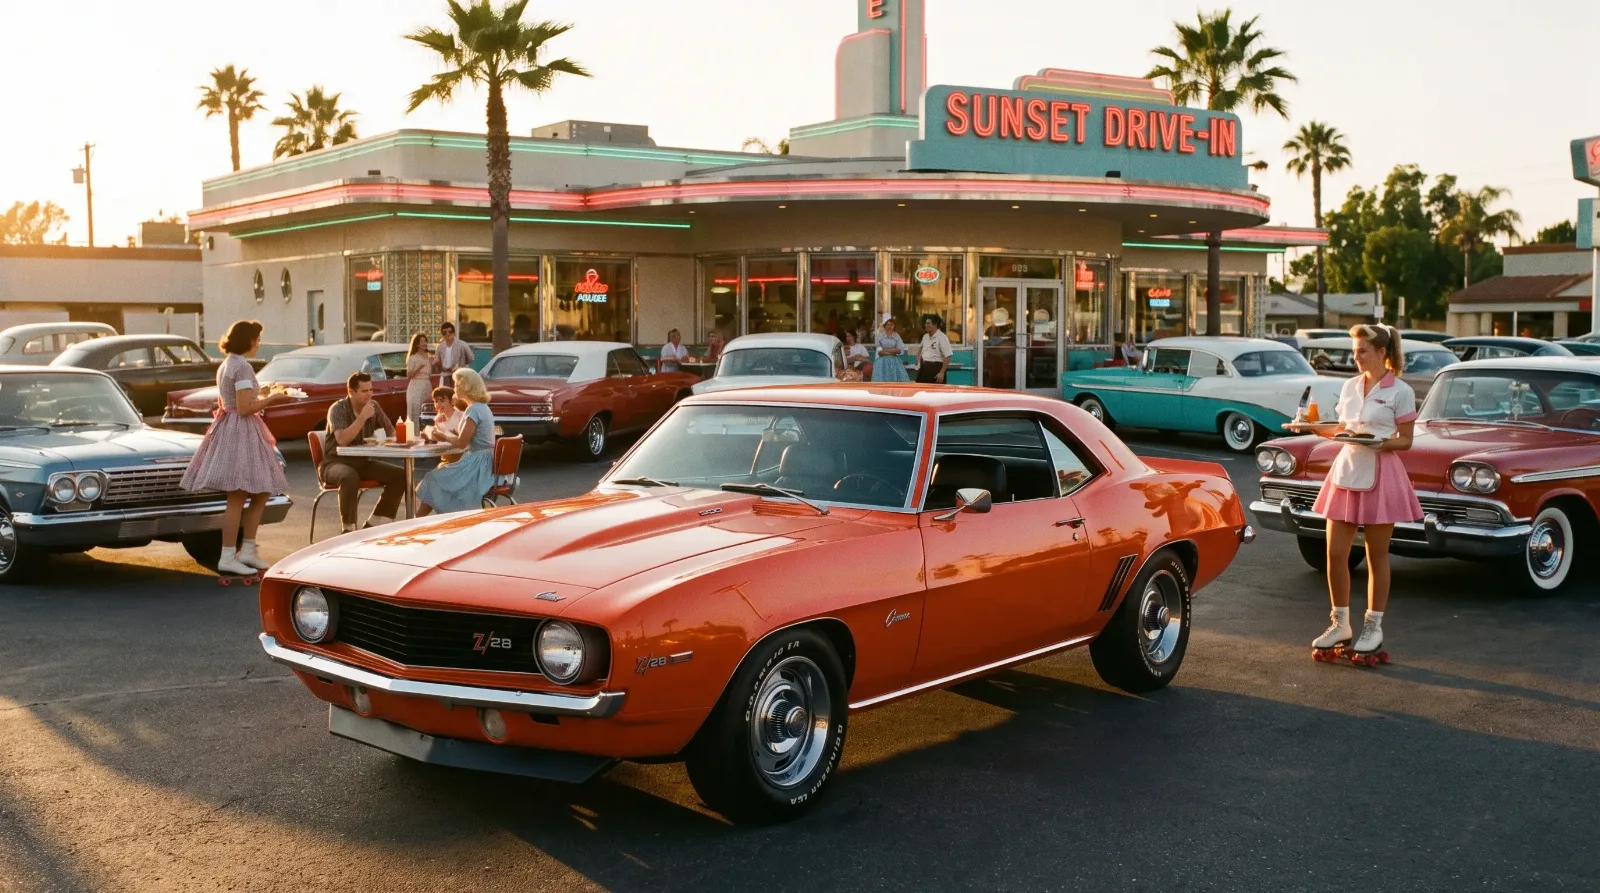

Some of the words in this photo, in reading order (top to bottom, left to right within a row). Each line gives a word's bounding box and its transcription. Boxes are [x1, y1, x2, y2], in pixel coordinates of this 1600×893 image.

[945, 91, 1091, 143] SUNSET
[1104, 105, 1236, 157] DRIVE-IN
[472, 630, 512, 655] Z/28
[635, 652, 667, 675] Z/28
